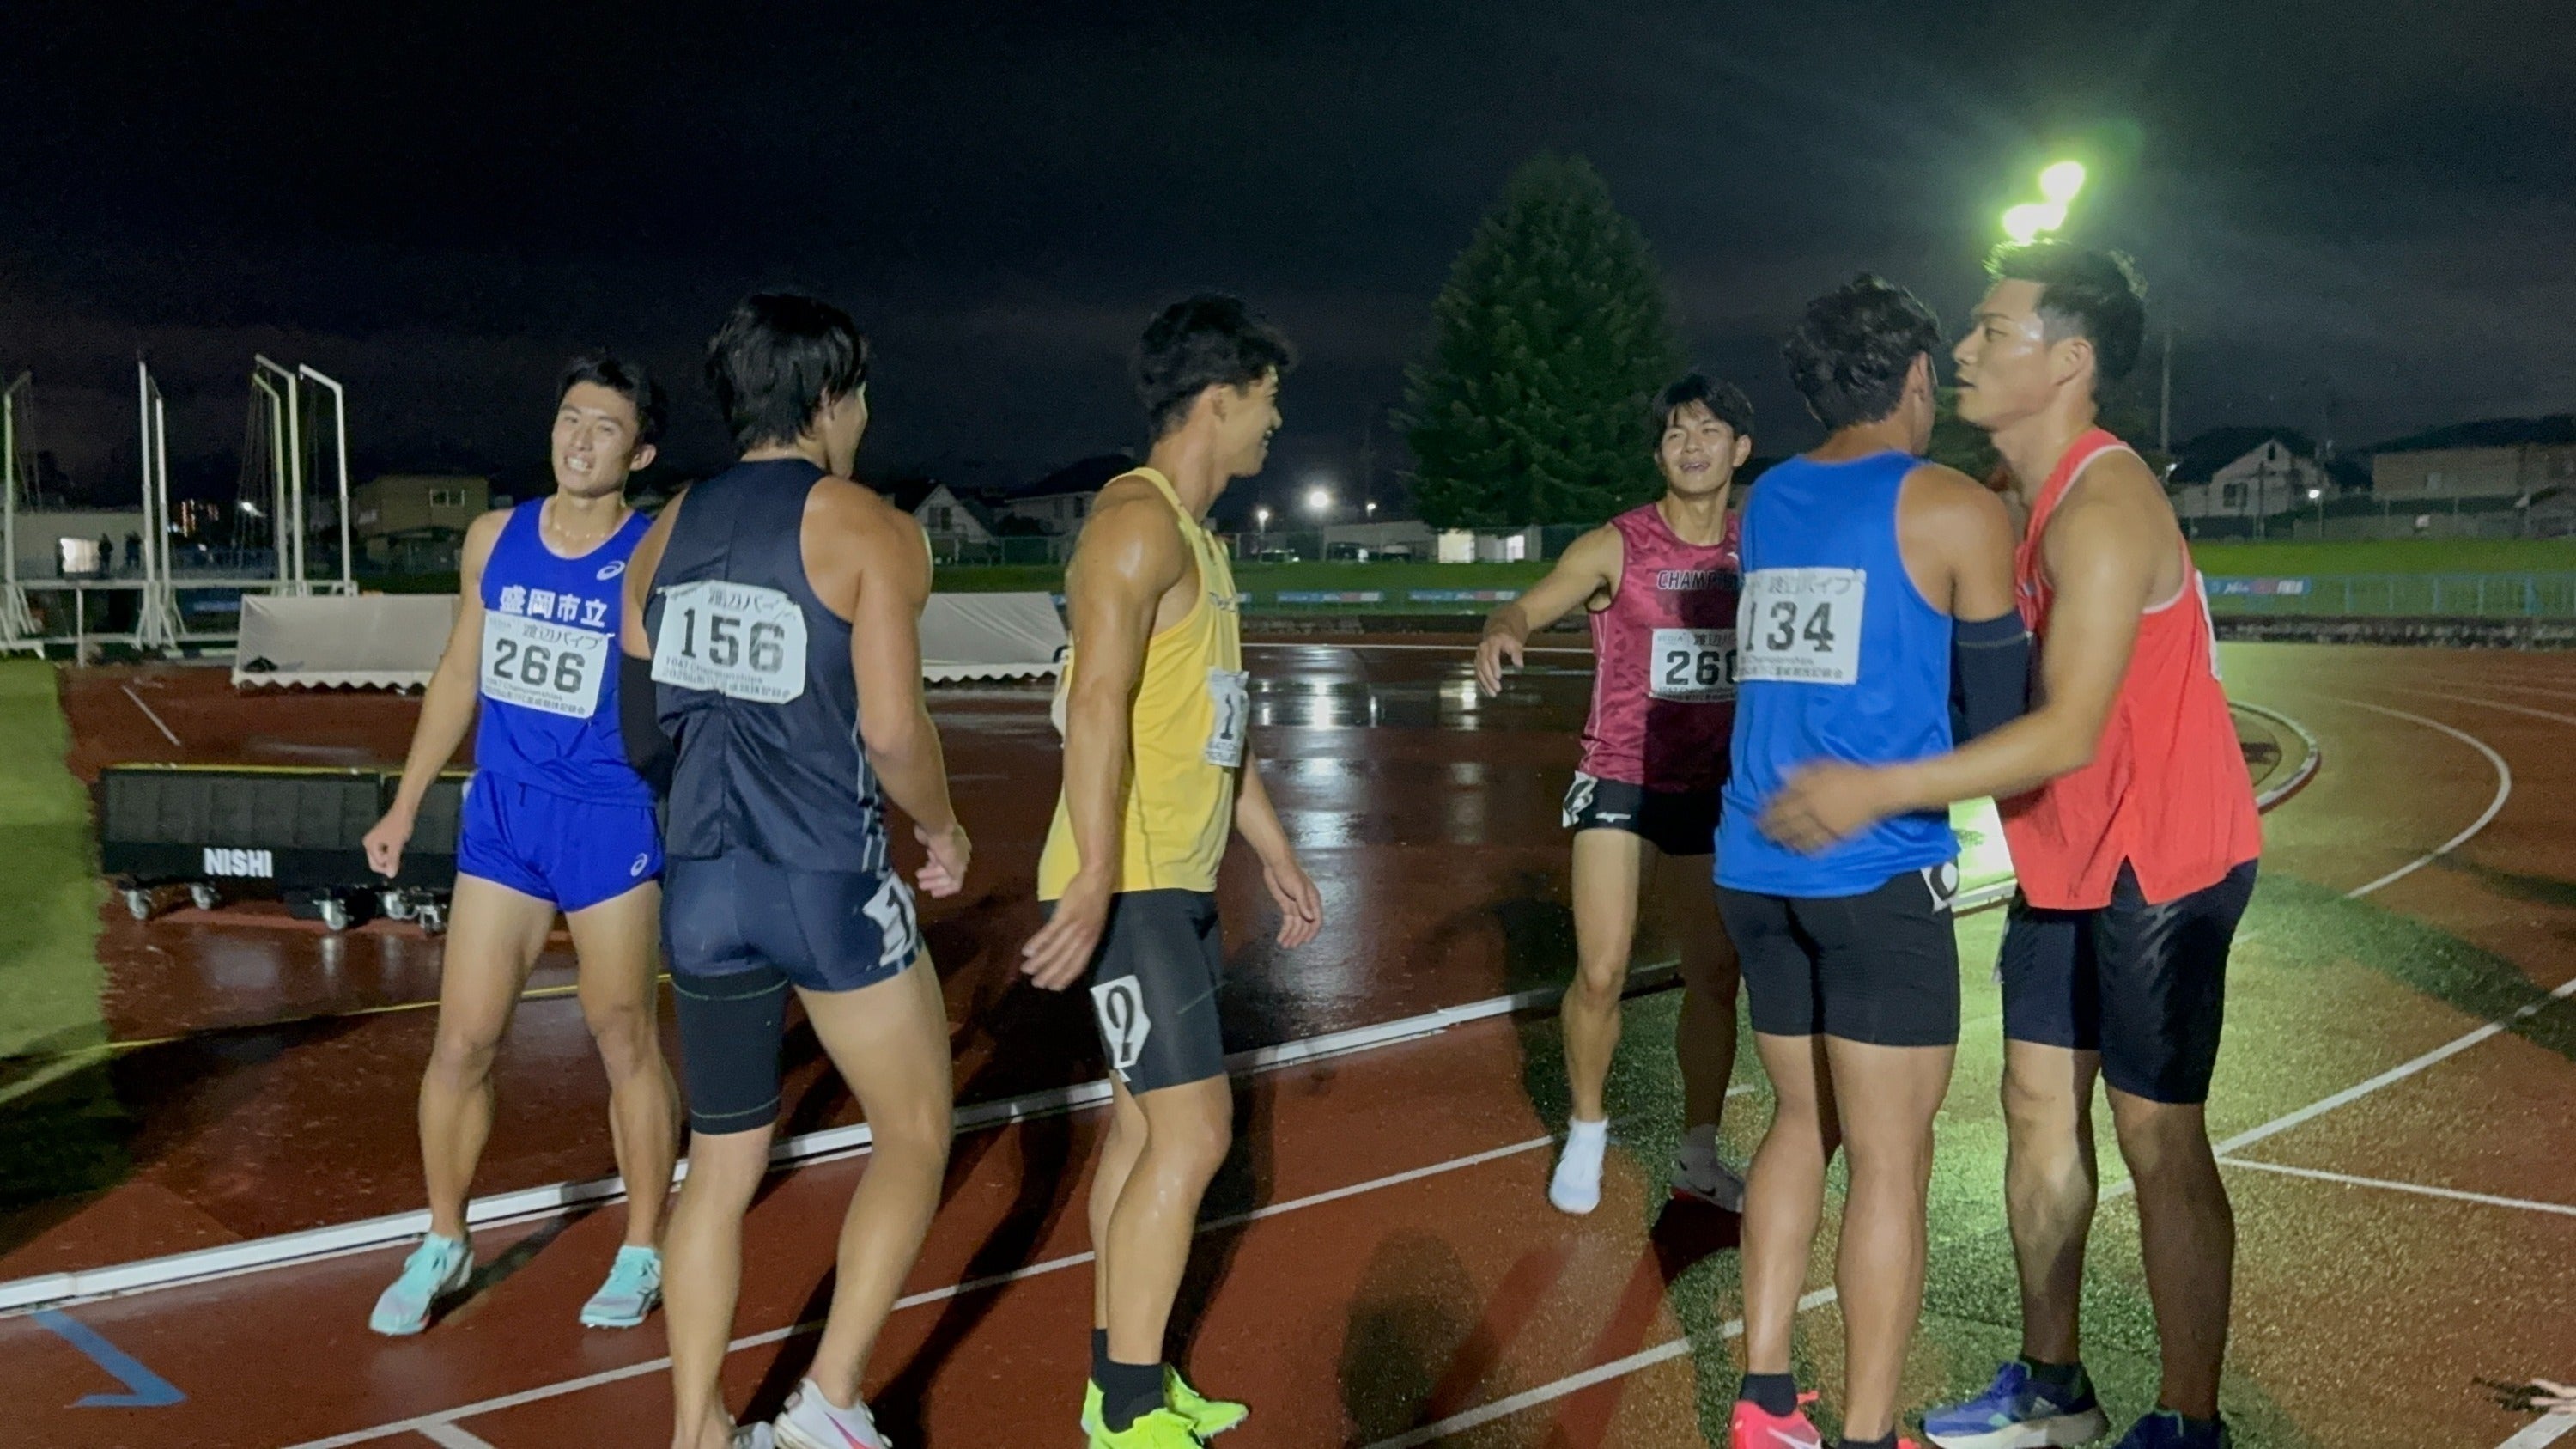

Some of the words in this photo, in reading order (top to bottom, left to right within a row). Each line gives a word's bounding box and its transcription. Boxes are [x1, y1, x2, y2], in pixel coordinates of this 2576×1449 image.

[499, 584, 607, 628] 盛岡市立
[1745, 600, 1835, 653] 134
[493, 638, 586, 693] 266
[681, 606, 785, 673] 156
[204, 848, 273, 878] NISHI
